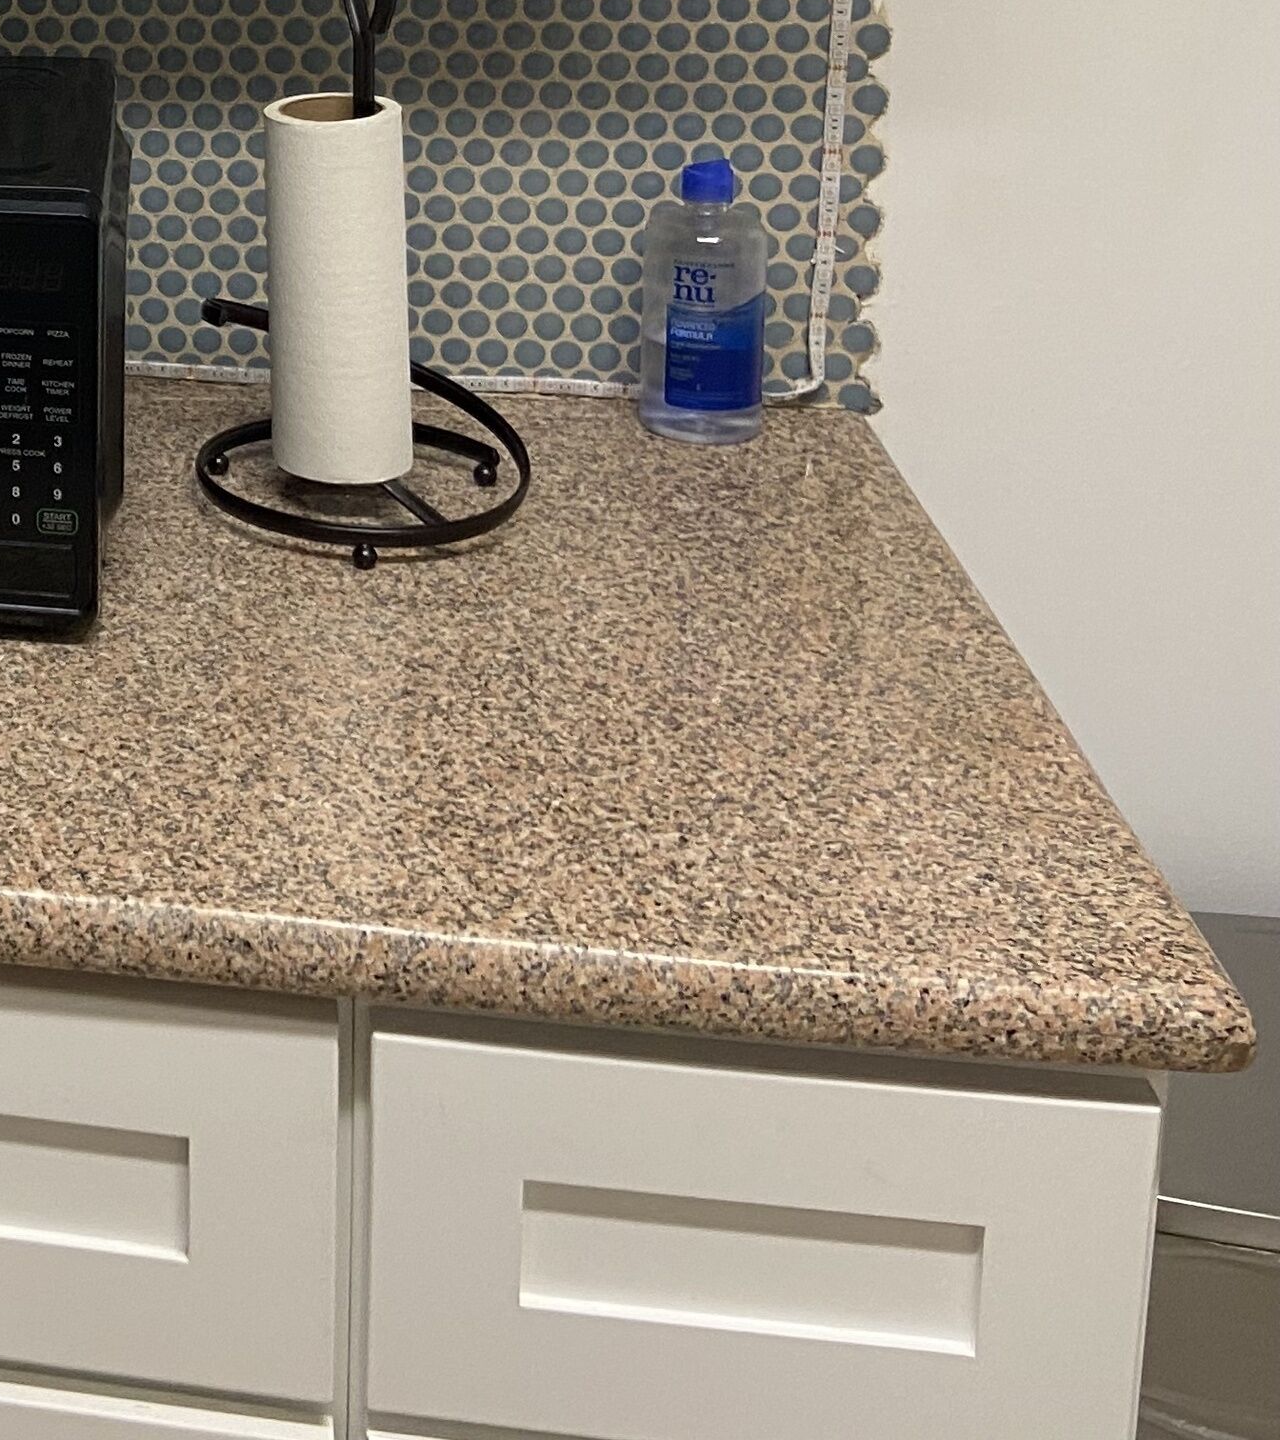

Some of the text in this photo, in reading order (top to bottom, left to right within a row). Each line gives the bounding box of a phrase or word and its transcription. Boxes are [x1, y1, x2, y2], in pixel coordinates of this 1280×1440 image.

[673, 282, 715, 303] nu
[11, 433, 21, 445] 2
[53, 435, 63, 448] 3
[23, 449, 47, 458] COOK
[11, 459, 21, 471] 5
[53, 462, 63, 474] 6
[11, 486, 21, 498] 8
[53, 488, 63, 501] 9
[11, 513, 21, 525] 0
[43, 512, 72, 521] START
